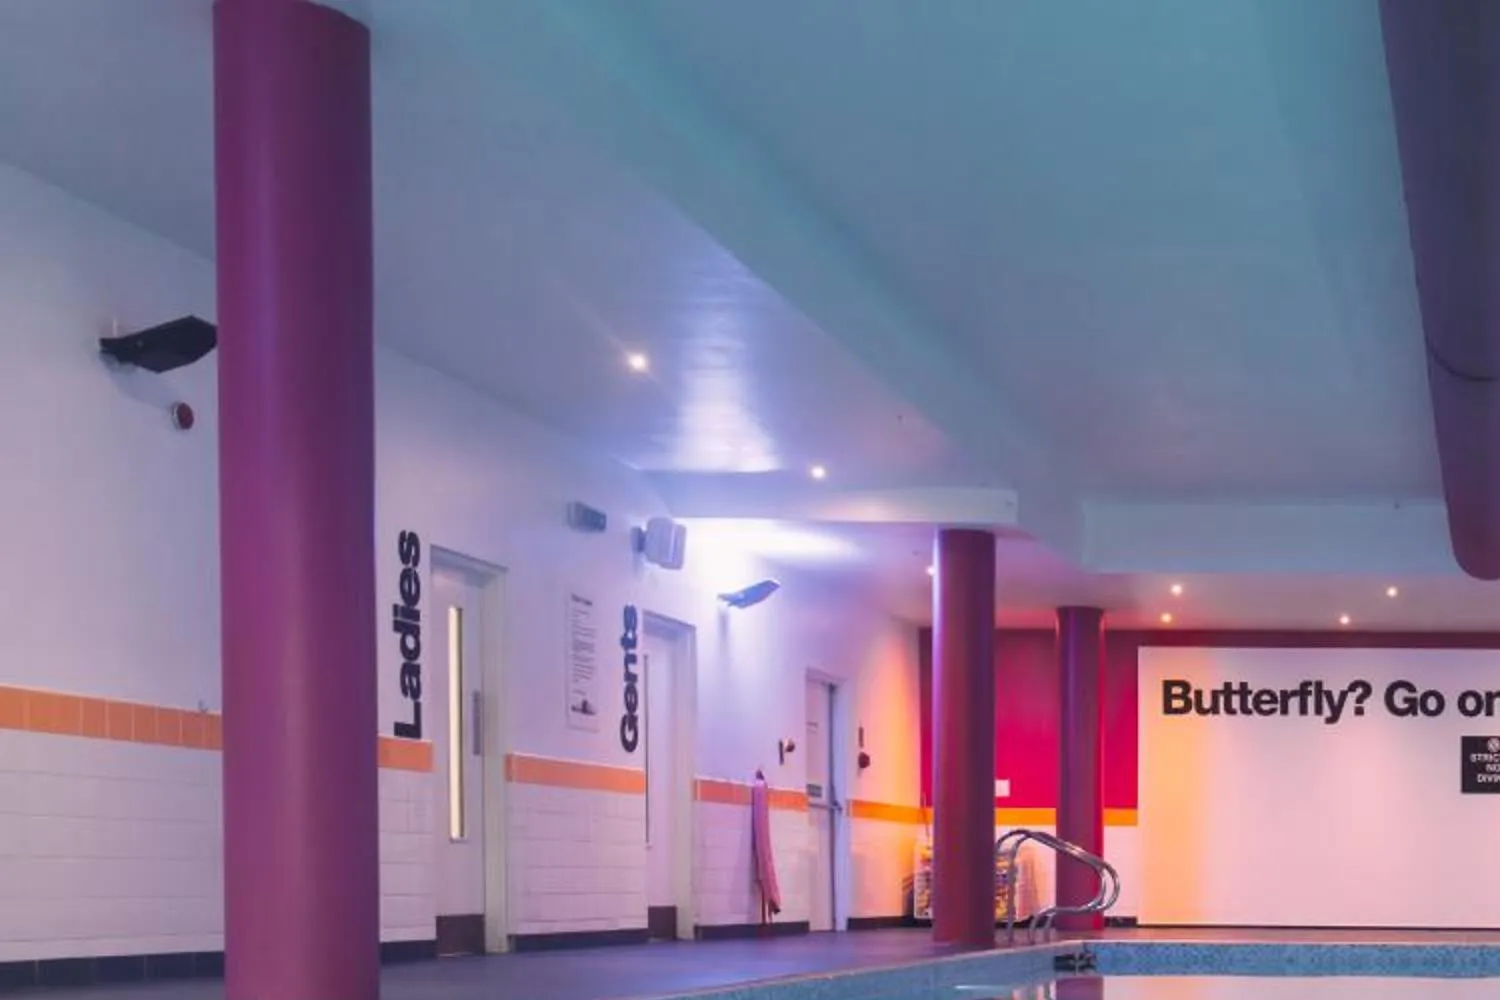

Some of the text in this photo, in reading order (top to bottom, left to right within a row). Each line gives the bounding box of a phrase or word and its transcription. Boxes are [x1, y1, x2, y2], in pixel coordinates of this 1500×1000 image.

[393, 530, 422, 739] Ladies
[620, 605, 639, 753] Gents
[1161, 679, 1373, 725] Butterfly?
[1384, 679, 1446, 717] Go
